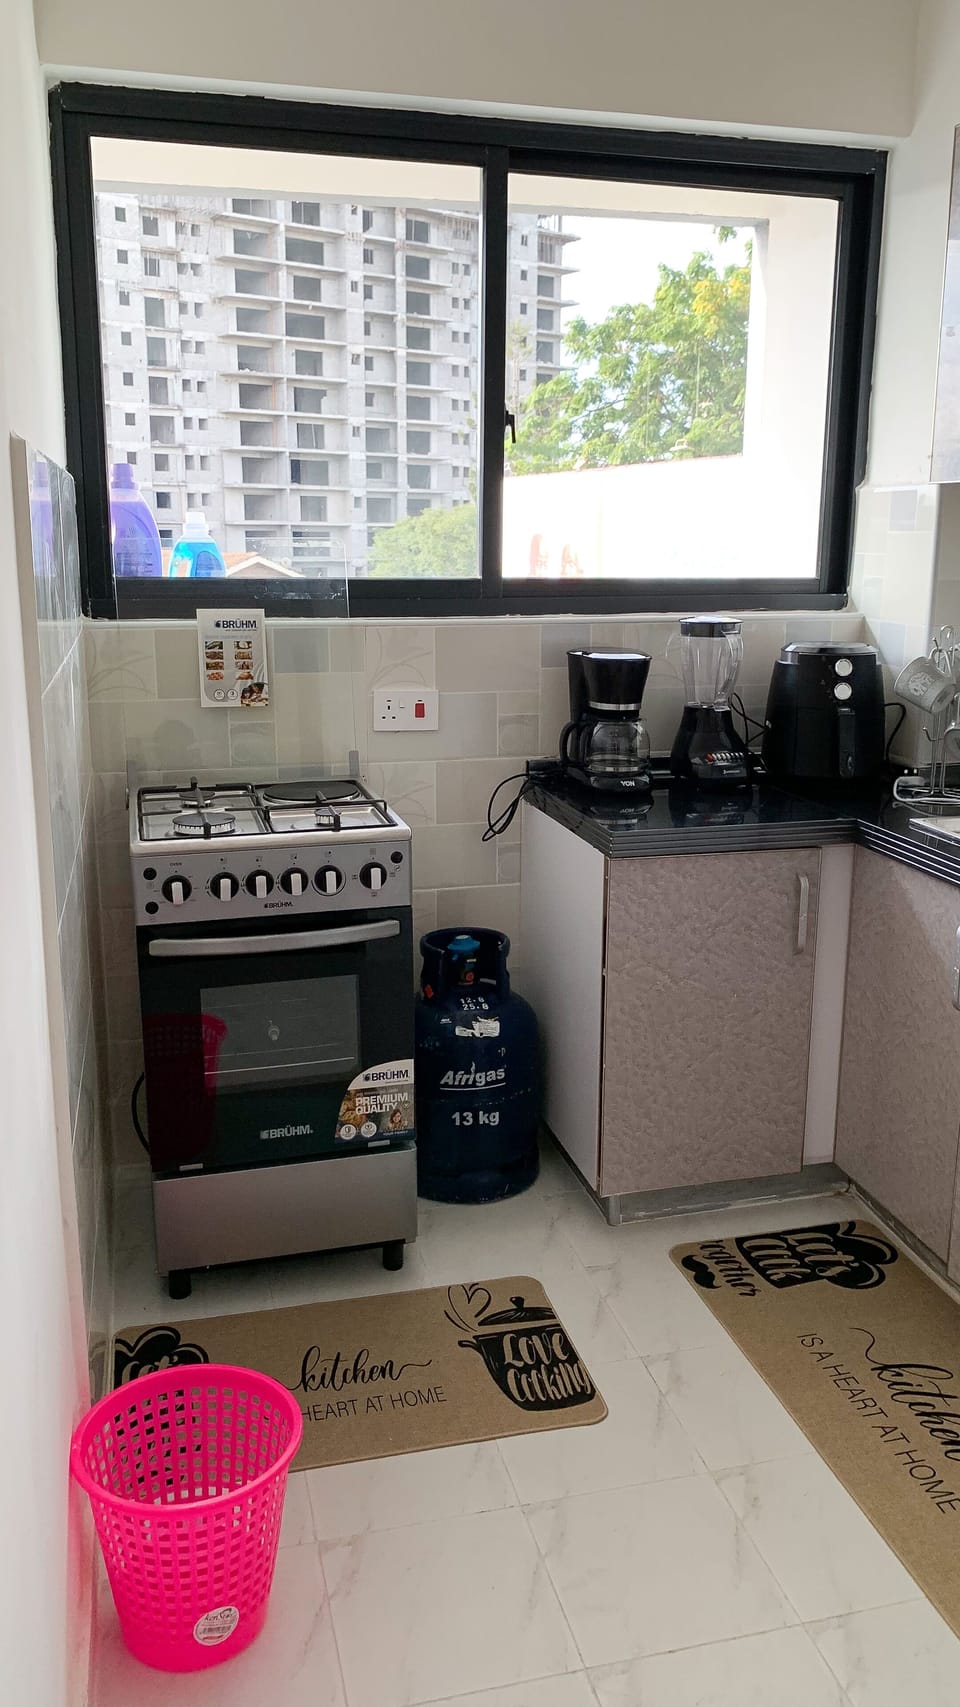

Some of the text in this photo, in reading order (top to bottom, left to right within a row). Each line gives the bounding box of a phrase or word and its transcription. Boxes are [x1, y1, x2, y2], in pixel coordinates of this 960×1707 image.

[222, 618, 257, 629] BRÜHM
[440, 1067, 506, 1086] Afrigas
[355, 1092, 408, 1107] PREMIUM
[355, 1102, 398, 1115] QUALITY
[452, 1111, 500, 1126] 13 kg
[297, 1345, 433, 1393] kitchen
[364, 1397, 384, 1414] AT
[391, 1386, 447, 1408] HOME
[797, 1333, 960, 1514] IS A HEART AT HOME
